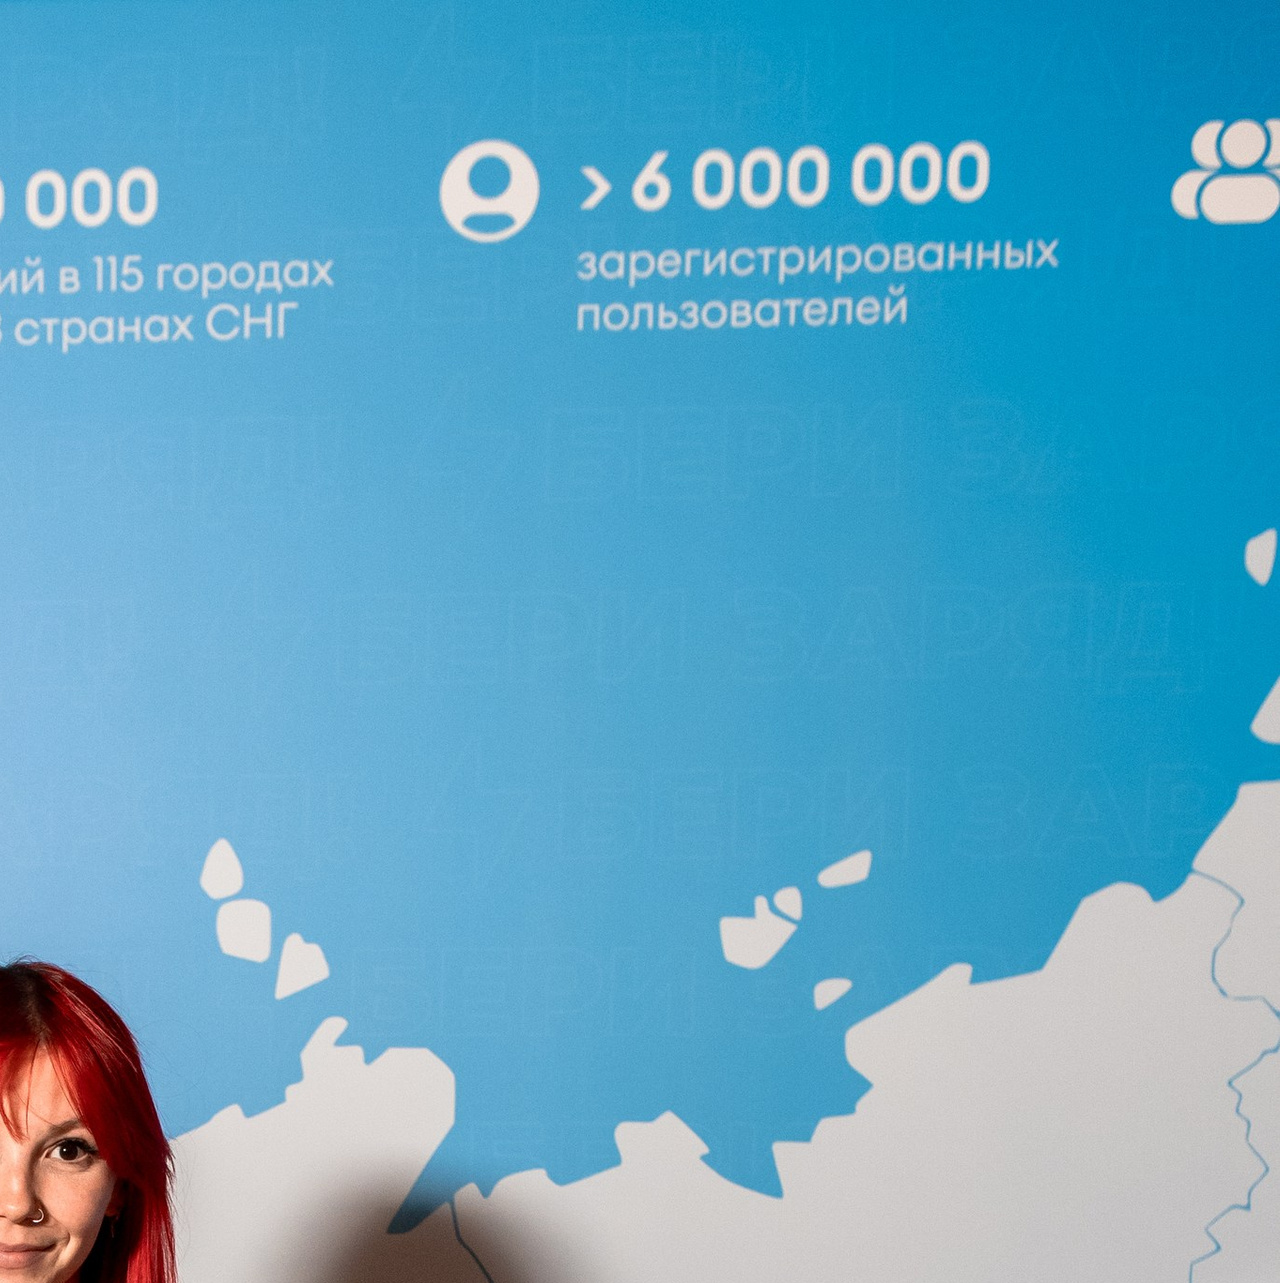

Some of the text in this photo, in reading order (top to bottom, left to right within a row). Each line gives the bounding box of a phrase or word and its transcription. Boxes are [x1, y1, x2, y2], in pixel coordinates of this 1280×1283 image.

[26, 167, 158, 229] 000
[632, 151, 671, 211] 6
[692, 146, 829, 210] 000
[851, 141, 990, 206] 000
[59, 267, 80, 294] в
[93, 256, 144, 292] 115
[157, 260, 333, 299] городах
[576, 240, 1058, 288] зарегистрированных
[14, 315, 193, 354] странах
[206, 302, 298, 341] СНГ
[577, 286, 907, 331] пользователей
